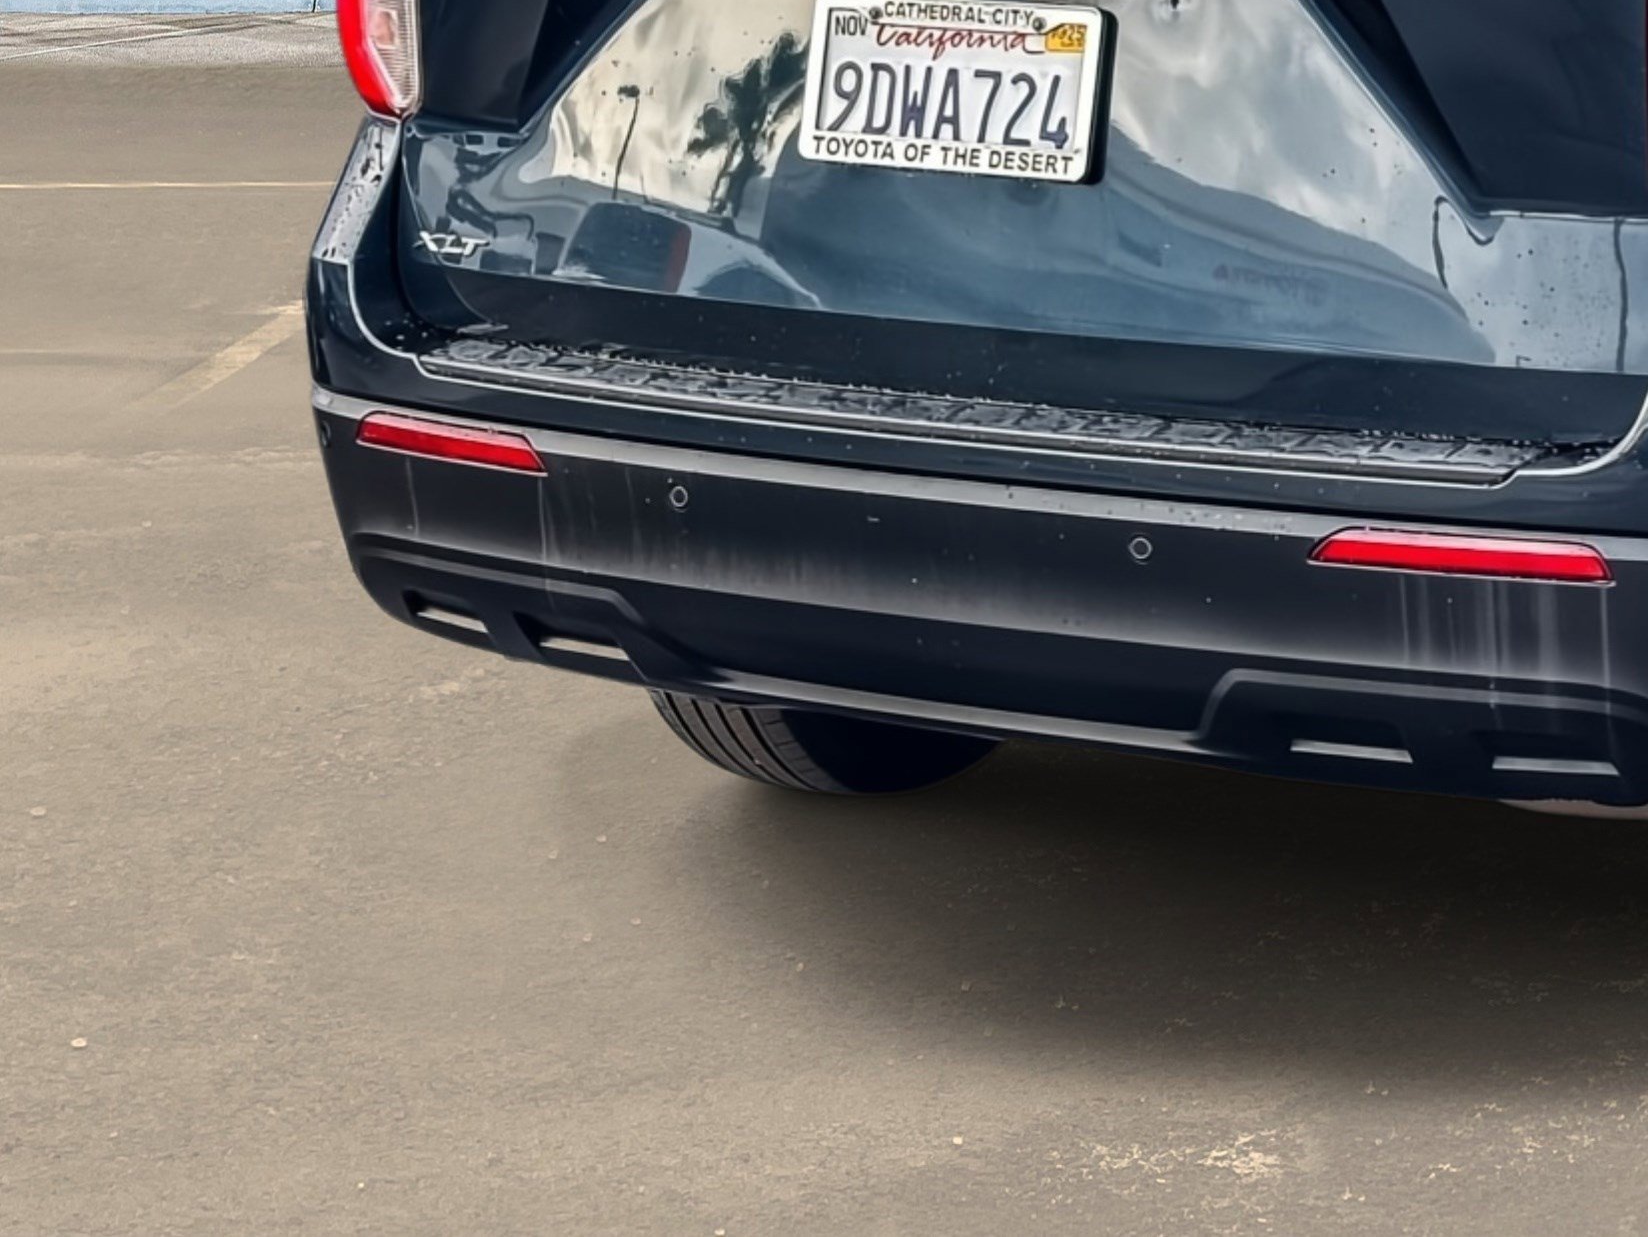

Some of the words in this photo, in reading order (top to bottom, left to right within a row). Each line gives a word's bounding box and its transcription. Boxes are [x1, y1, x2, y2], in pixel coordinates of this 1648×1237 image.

[834, 15, 868, 37] NOV
[884, 1, 988, 25] CATHEDRAL
[992, 8, 1034, 28] CITY
[876, 23, 1046, 61] California
[828, 60, 1069, 150] 9DWA724
[813, 135, 895, 161] TOYOTA
[904, 143, 931, 163] OF
[940, 146, 981, 168] THE
[988, 150, 1074, 175] DESERT
